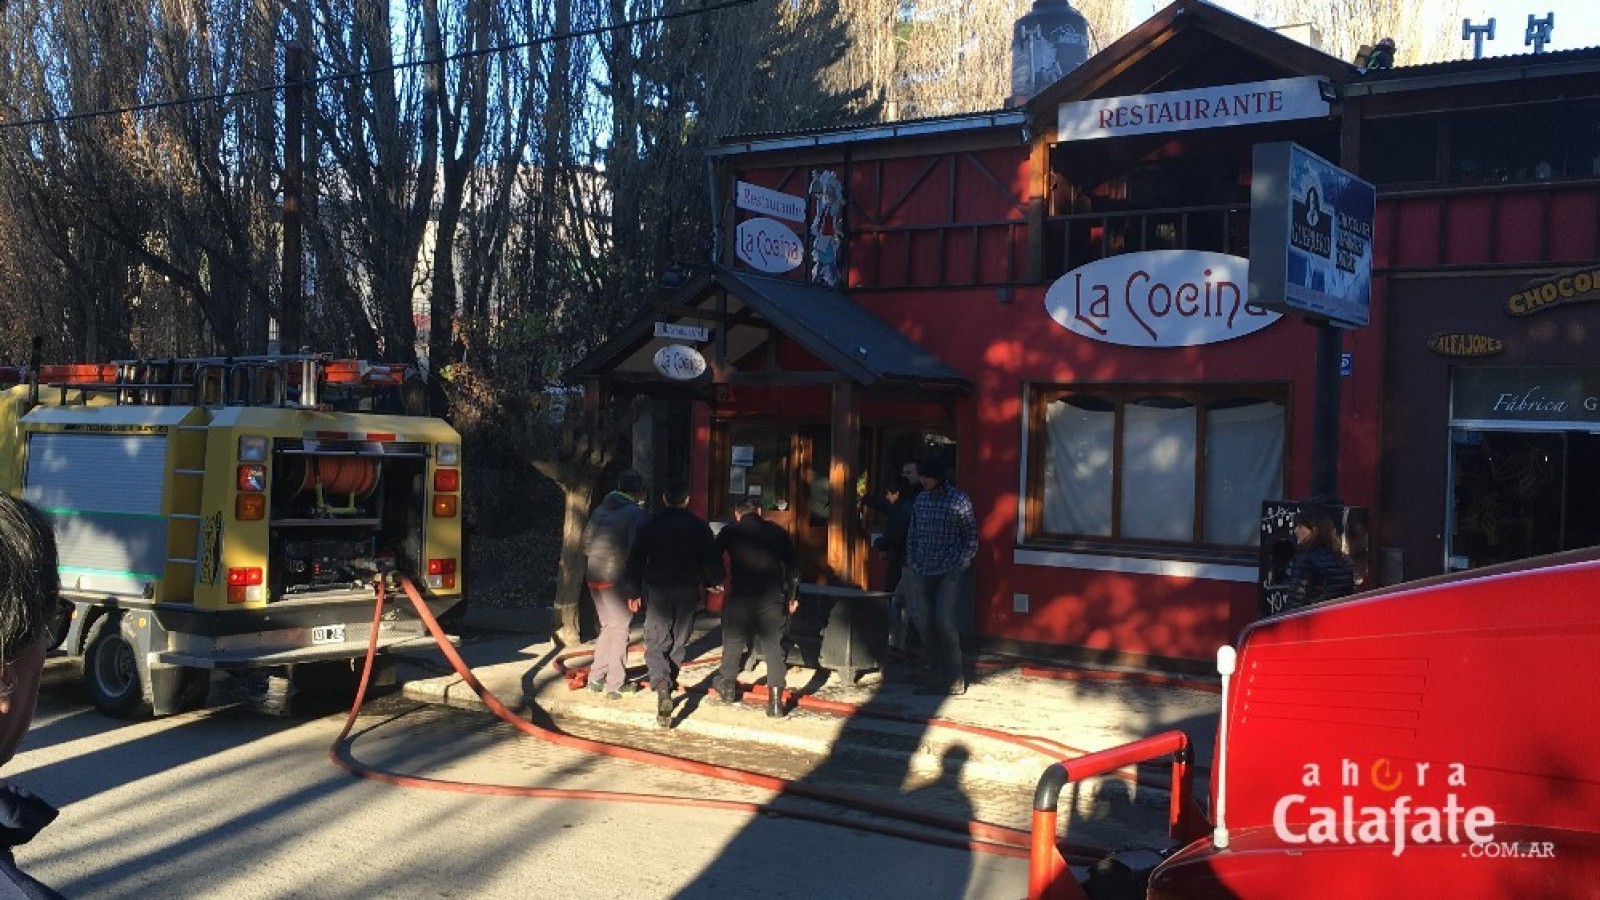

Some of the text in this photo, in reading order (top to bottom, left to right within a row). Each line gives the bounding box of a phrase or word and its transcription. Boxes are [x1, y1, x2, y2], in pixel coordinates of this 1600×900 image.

[1098, 90, 1284, 129] RESTAURANTE
[744, 188, 802, 217] Restaurante
[741, 227, 798, 266] La Cocina
[1075, 273, 1109, 335] La
